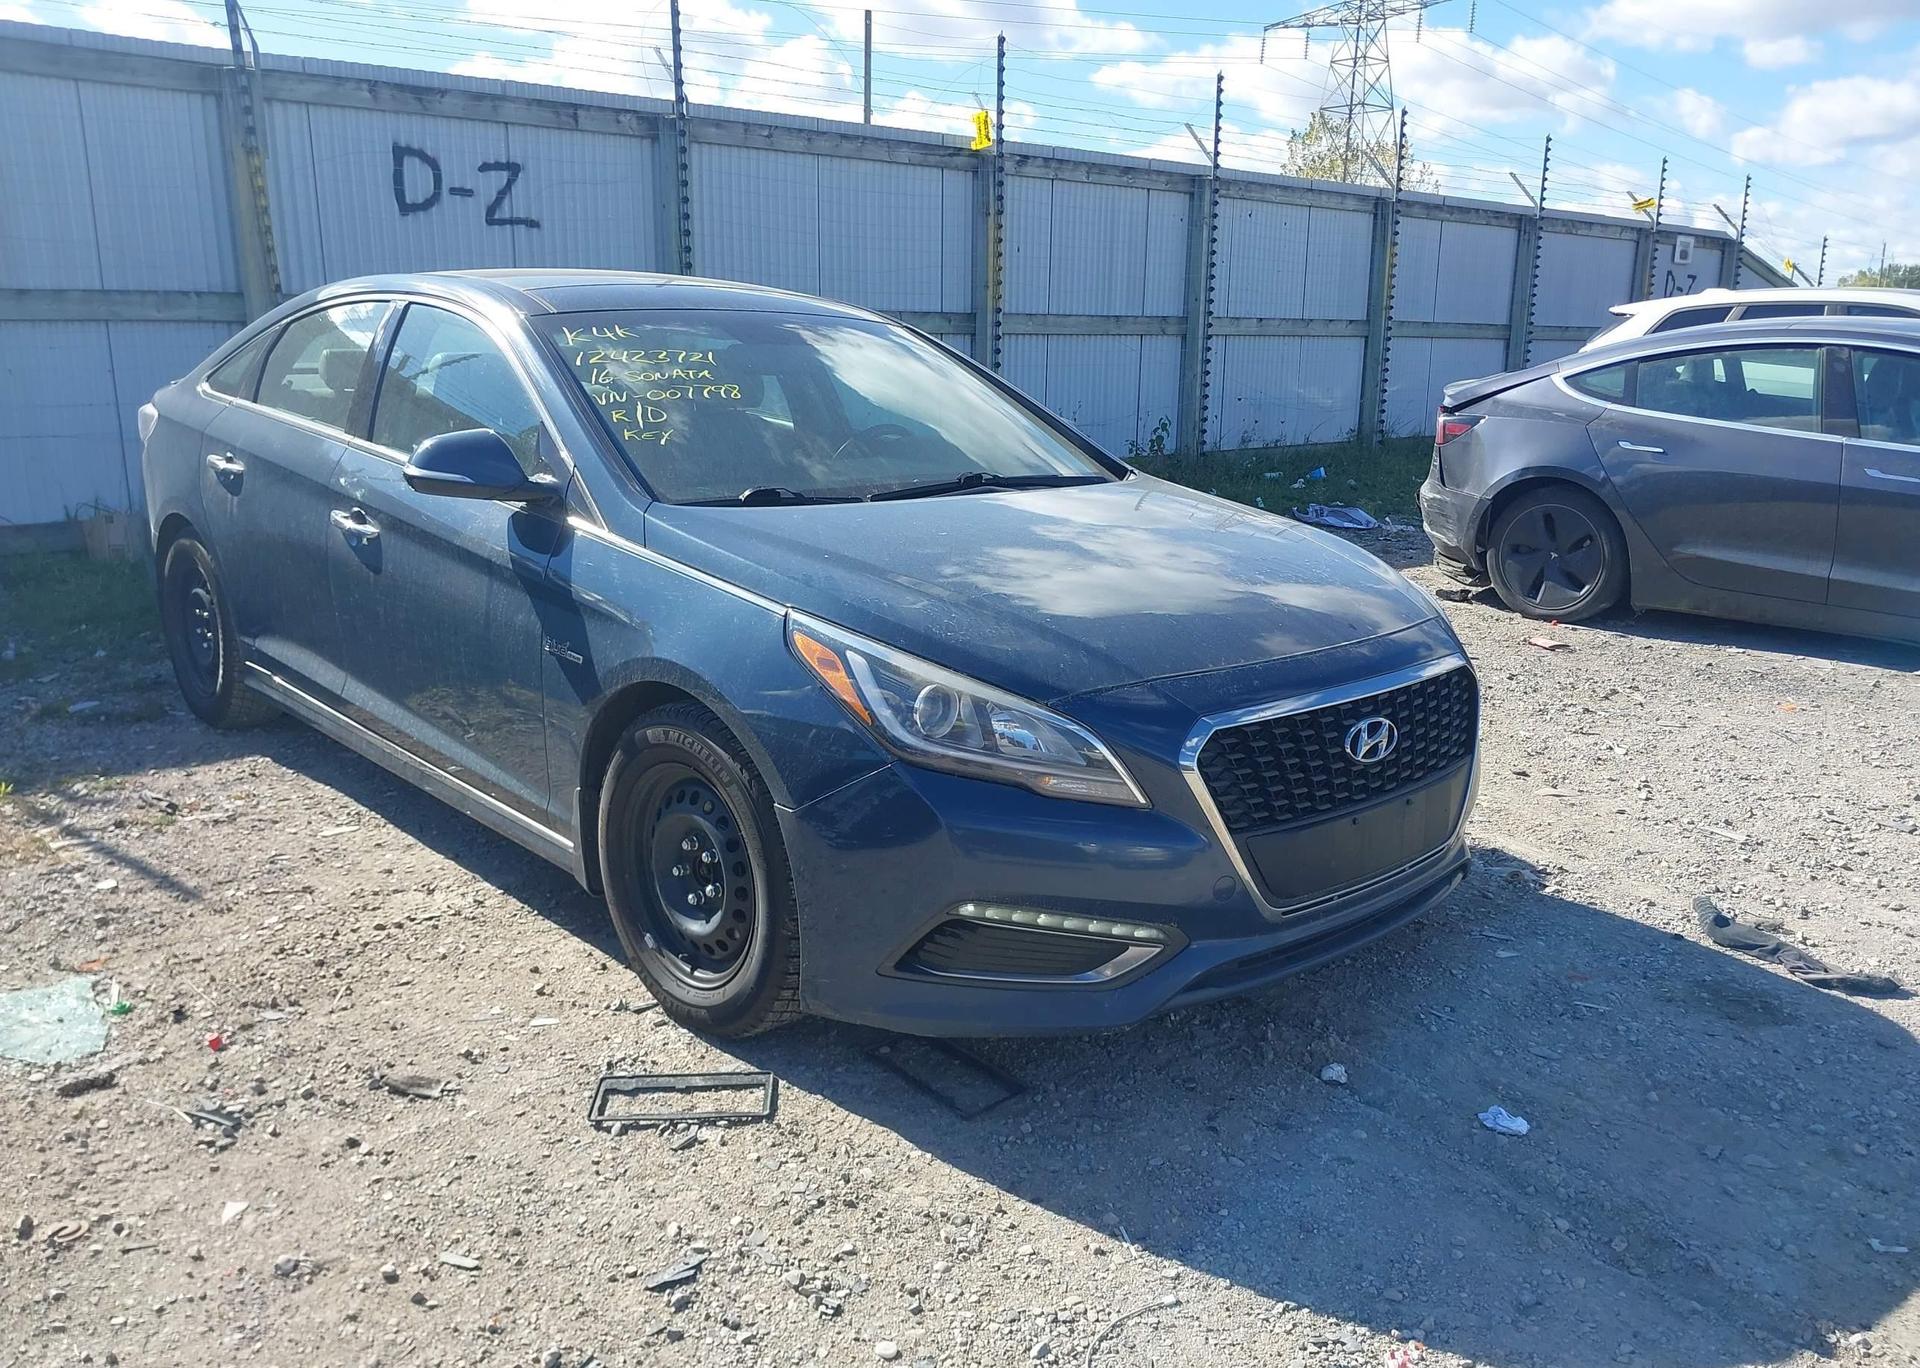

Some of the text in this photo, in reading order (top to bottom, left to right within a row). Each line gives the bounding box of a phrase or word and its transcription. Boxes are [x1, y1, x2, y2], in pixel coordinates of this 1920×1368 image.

[392, 142, 541, 228] D-Z
[575, 349, 718, 367] 12423721
[623, 428, 674, 445] KEY
[668, 730, 730, 785] MICHELIN
